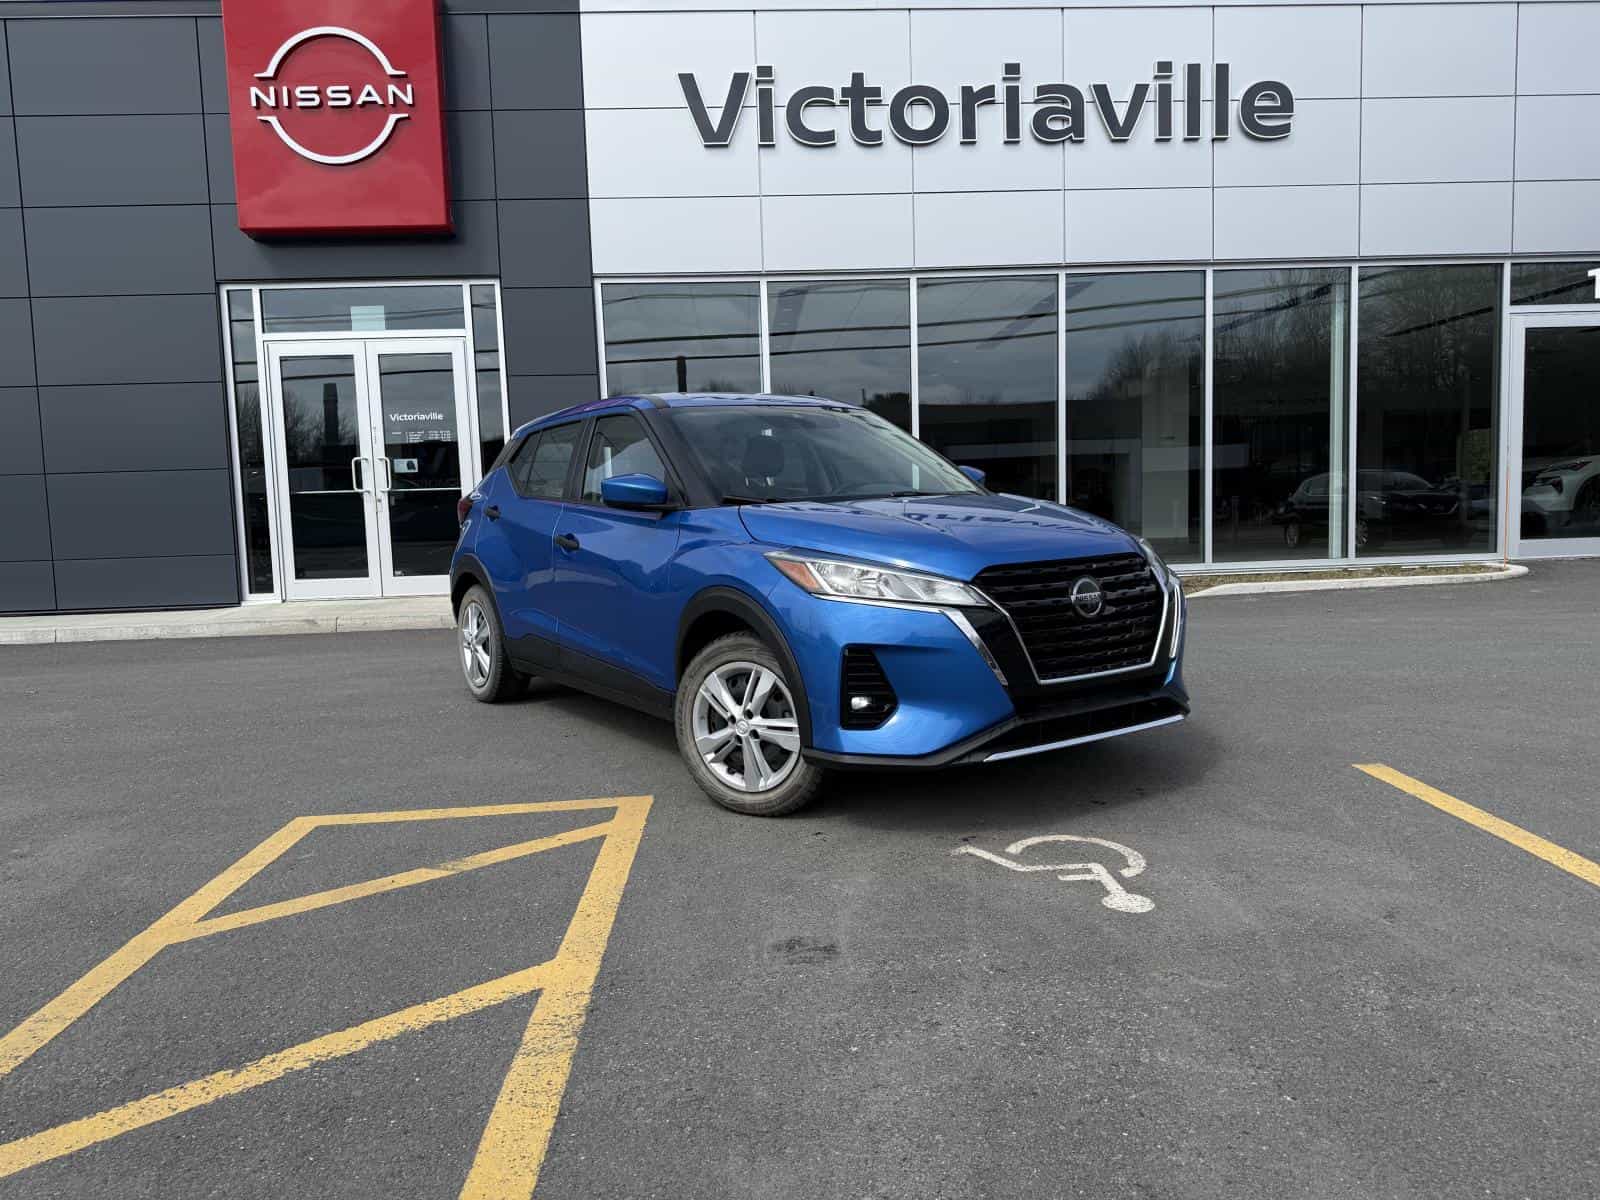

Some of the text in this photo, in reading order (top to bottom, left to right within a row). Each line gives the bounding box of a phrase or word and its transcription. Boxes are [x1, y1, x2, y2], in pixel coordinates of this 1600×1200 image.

[249, 83, 414, 108] NISSAN
[677, 61, 1295, 147] Victoriaville
[389, 411, 444, 422] Victoriaville
